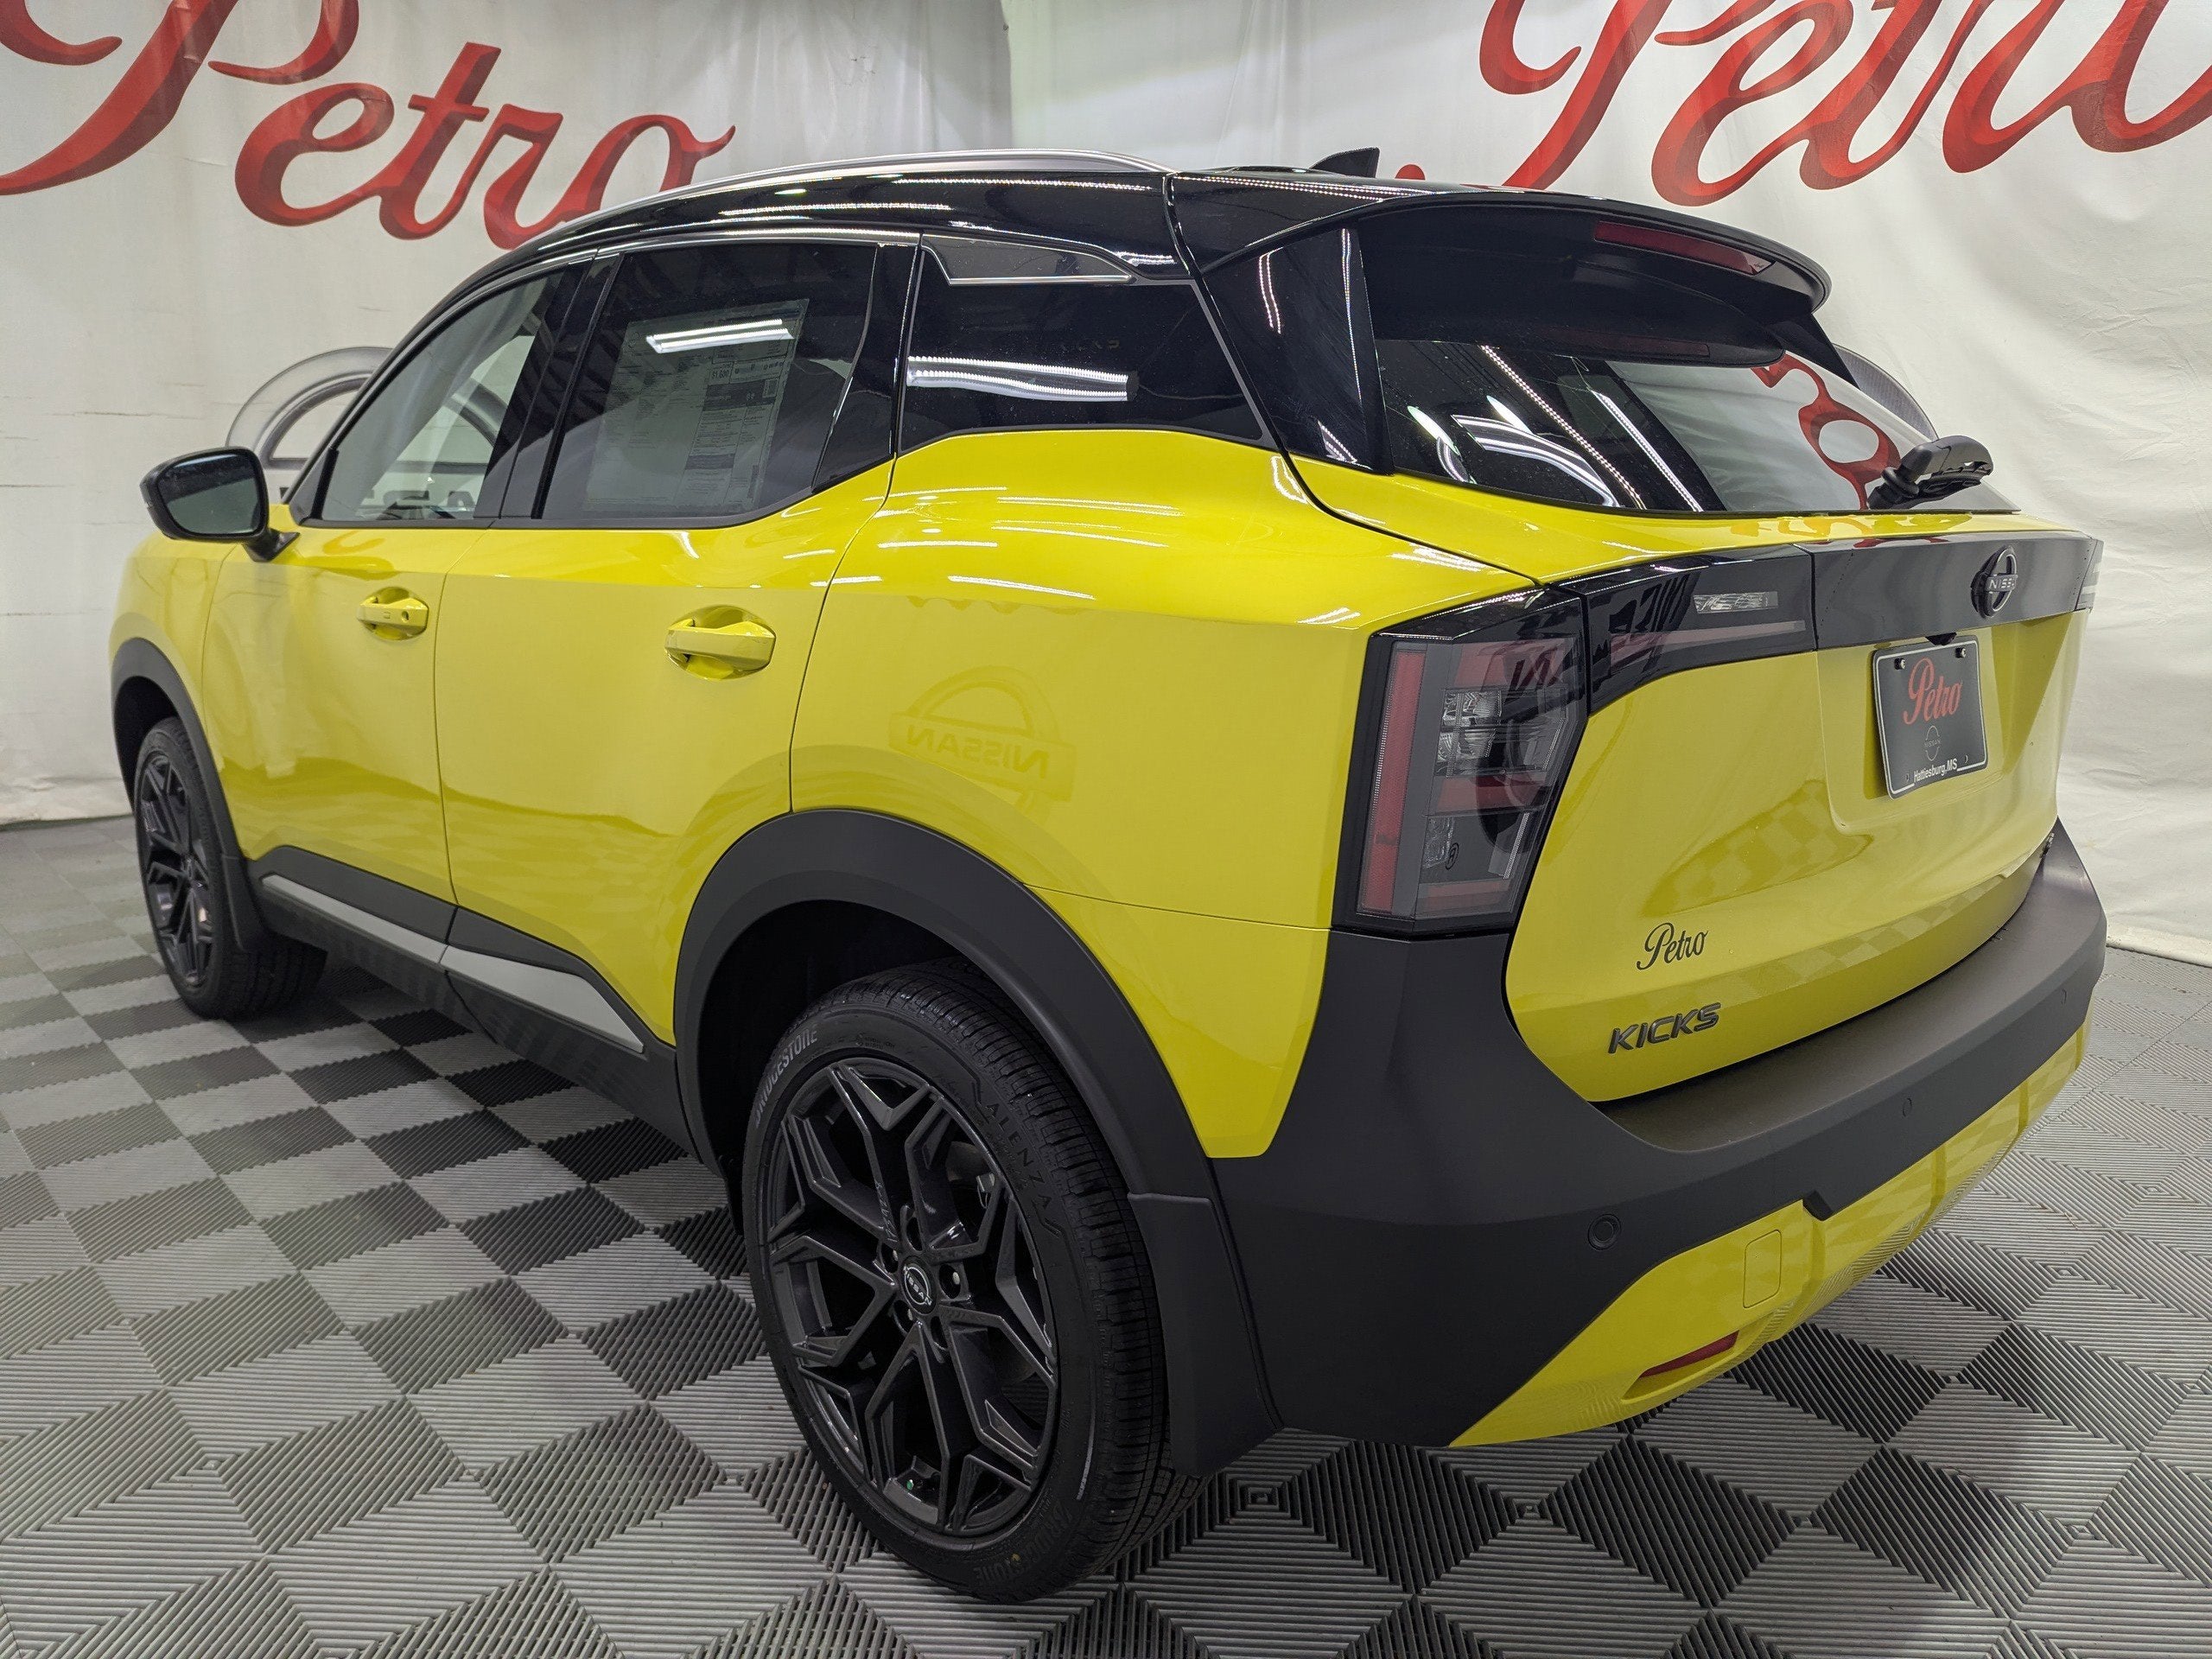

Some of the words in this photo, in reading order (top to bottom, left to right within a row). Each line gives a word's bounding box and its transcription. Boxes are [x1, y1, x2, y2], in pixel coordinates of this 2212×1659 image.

[1903, 657, 1962, 725] Petro
[1636, 922, 1709, 970] Petro
[1607, 1001, 1721, 1054] KICKS
[985, 1103, 1052, 1209] ALENZA
